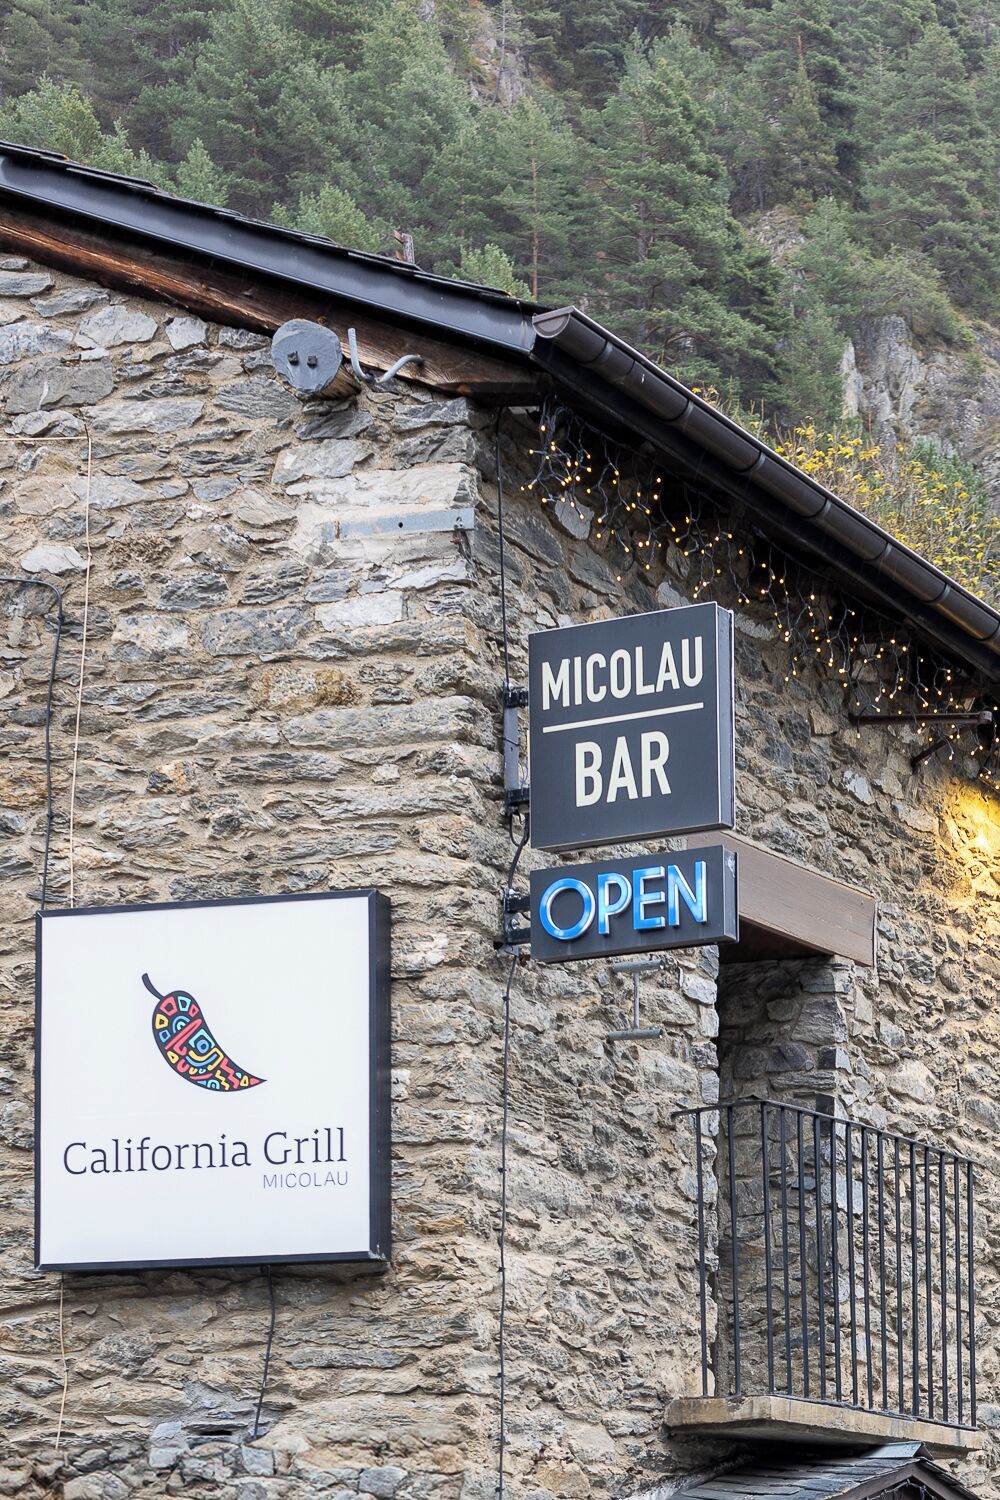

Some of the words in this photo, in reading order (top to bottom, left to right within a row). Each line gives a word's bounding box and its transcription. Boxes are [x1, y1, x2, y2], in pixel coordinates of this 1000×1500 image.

[542, 636, 704, 711] MICOLAU
[575, 731, 672, 808] BAR
[539, 860, 707, 940] OPEN
[63, 1134, 251, 1176] California
[263, 1127, 347, 1166] Grill
[263, 1171, 349, 1190] MICOLAU
